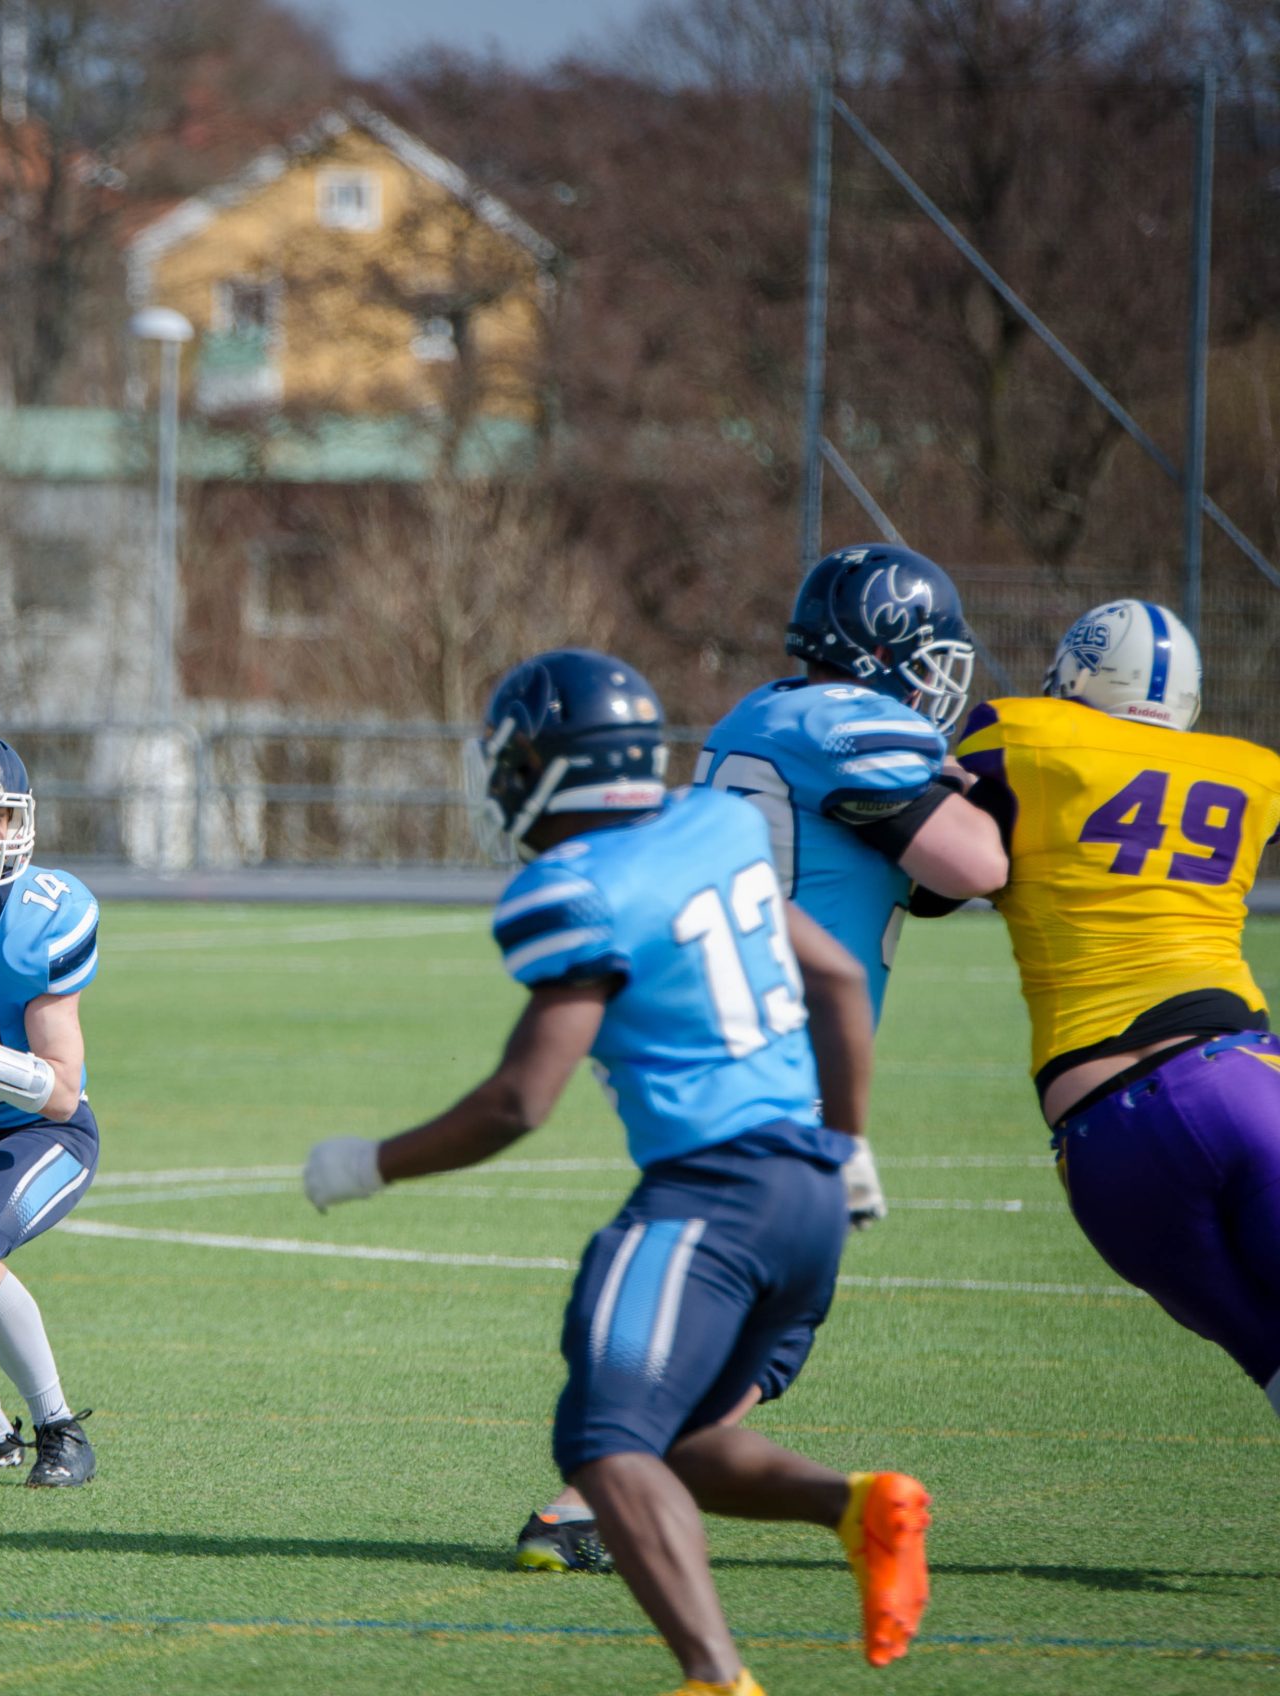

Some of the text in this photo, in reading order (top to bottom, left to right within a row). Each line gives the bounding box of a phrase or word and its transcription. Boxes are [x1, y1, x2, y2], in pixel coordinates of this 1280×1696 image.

[1128, 706, 1171, 721] Riddell
[1078, 768, 1249, 886] 49
[21, 873, 72, 912] 14
[673, 858, 810, 1059] 13
